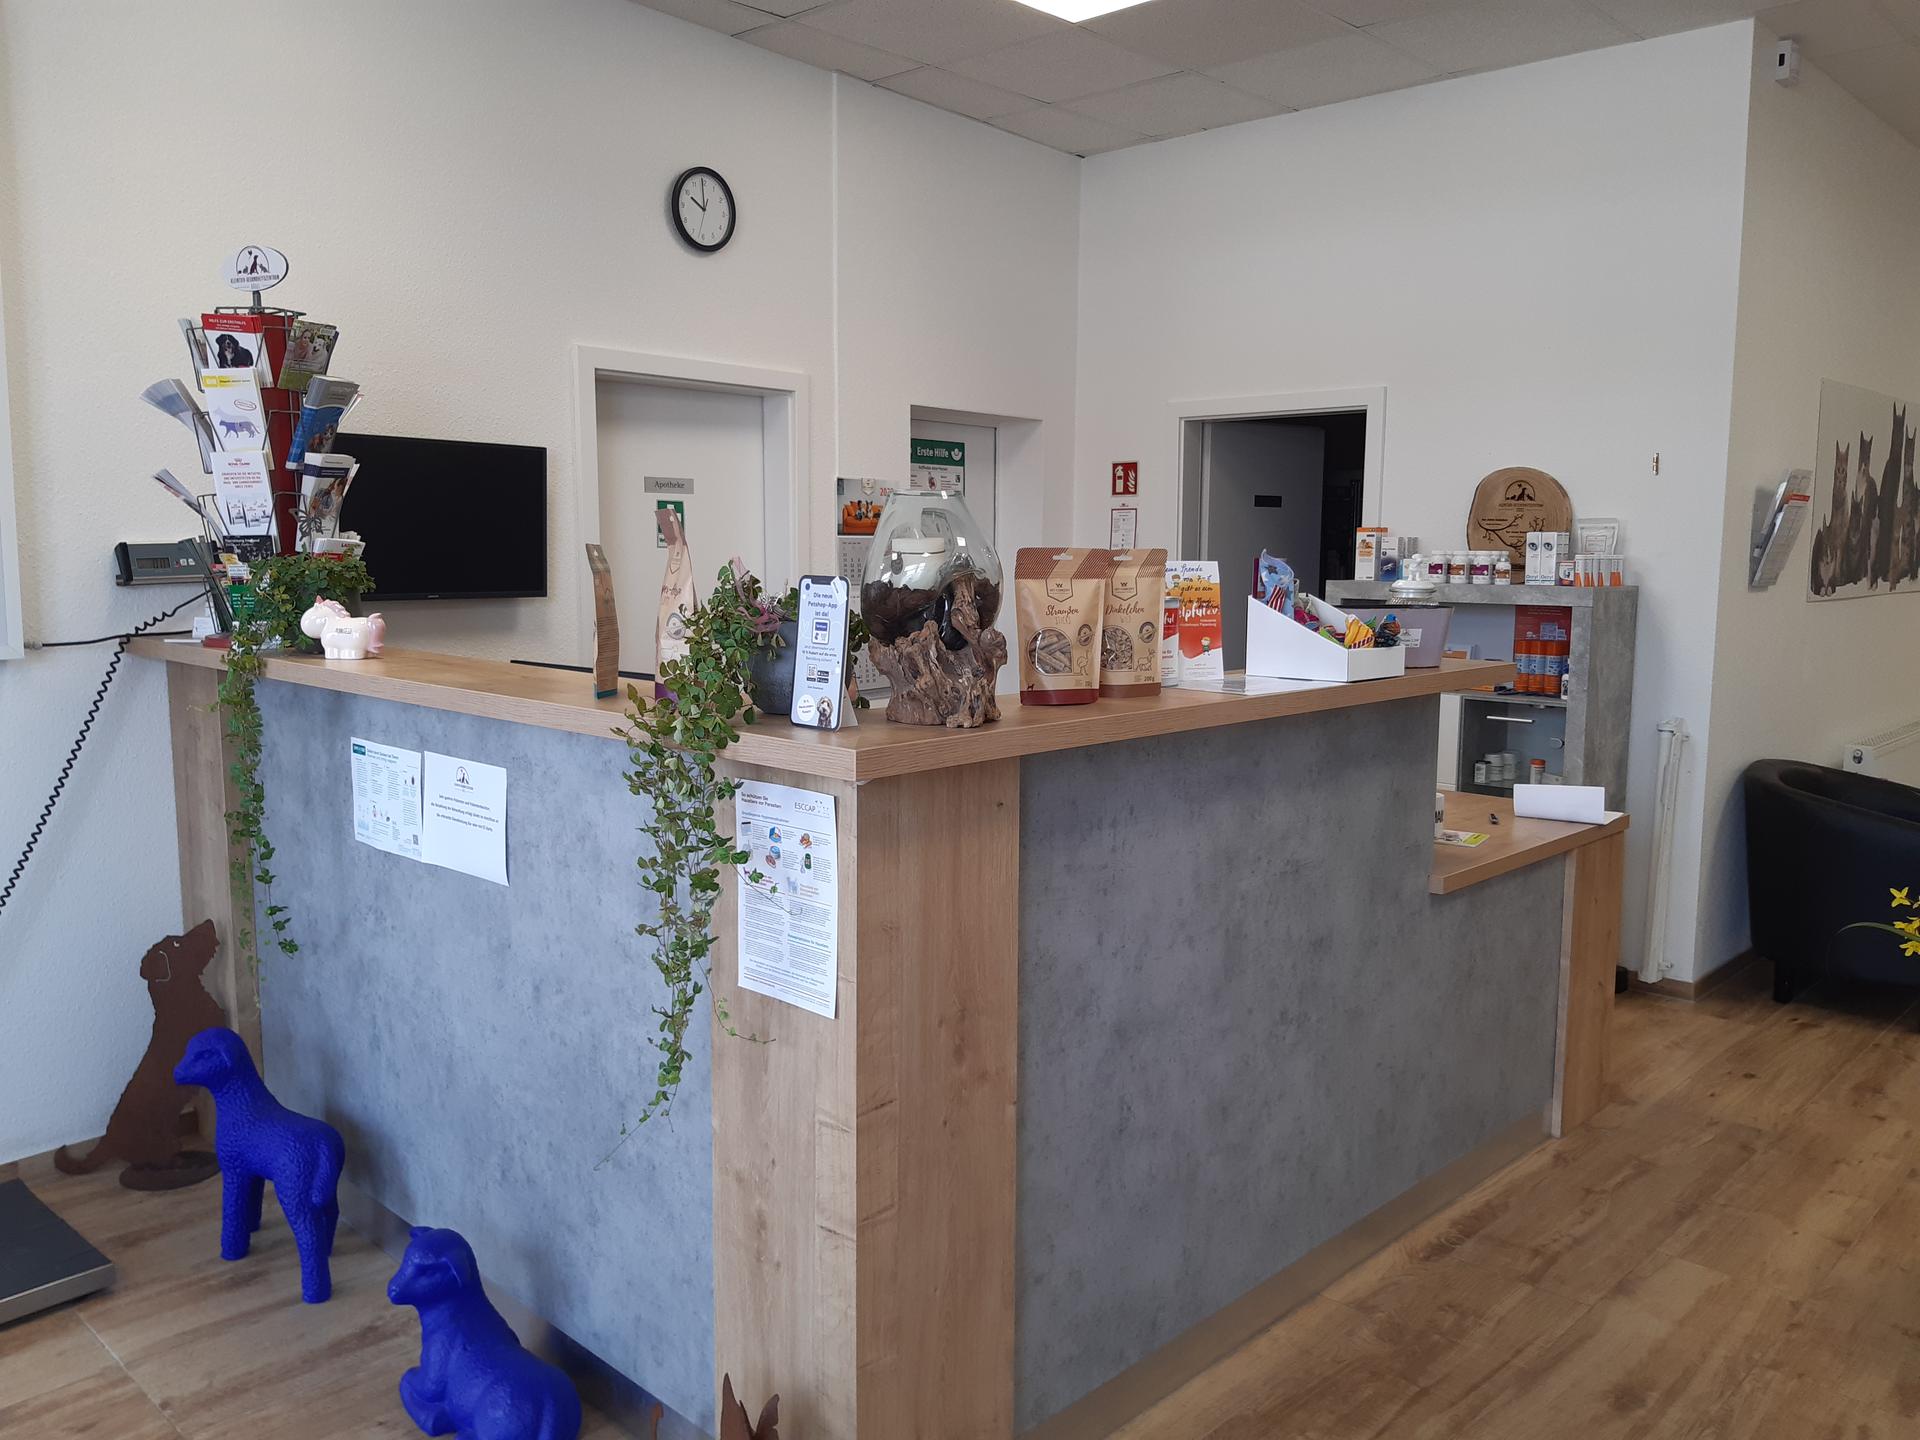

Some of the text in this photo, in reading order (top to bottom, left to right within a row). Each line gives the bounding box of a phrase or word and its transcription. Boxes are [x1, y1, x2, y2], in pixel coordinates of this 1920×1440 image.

[916, 446, 949, 458] Erste Hilfe
[654, 481, 685, 490] Apotheke
[1181, 564, 1203, 574] Spende
[1046, 604, 1079, 616] Straußen
[794, 802, 816, 812] ESCCAP
